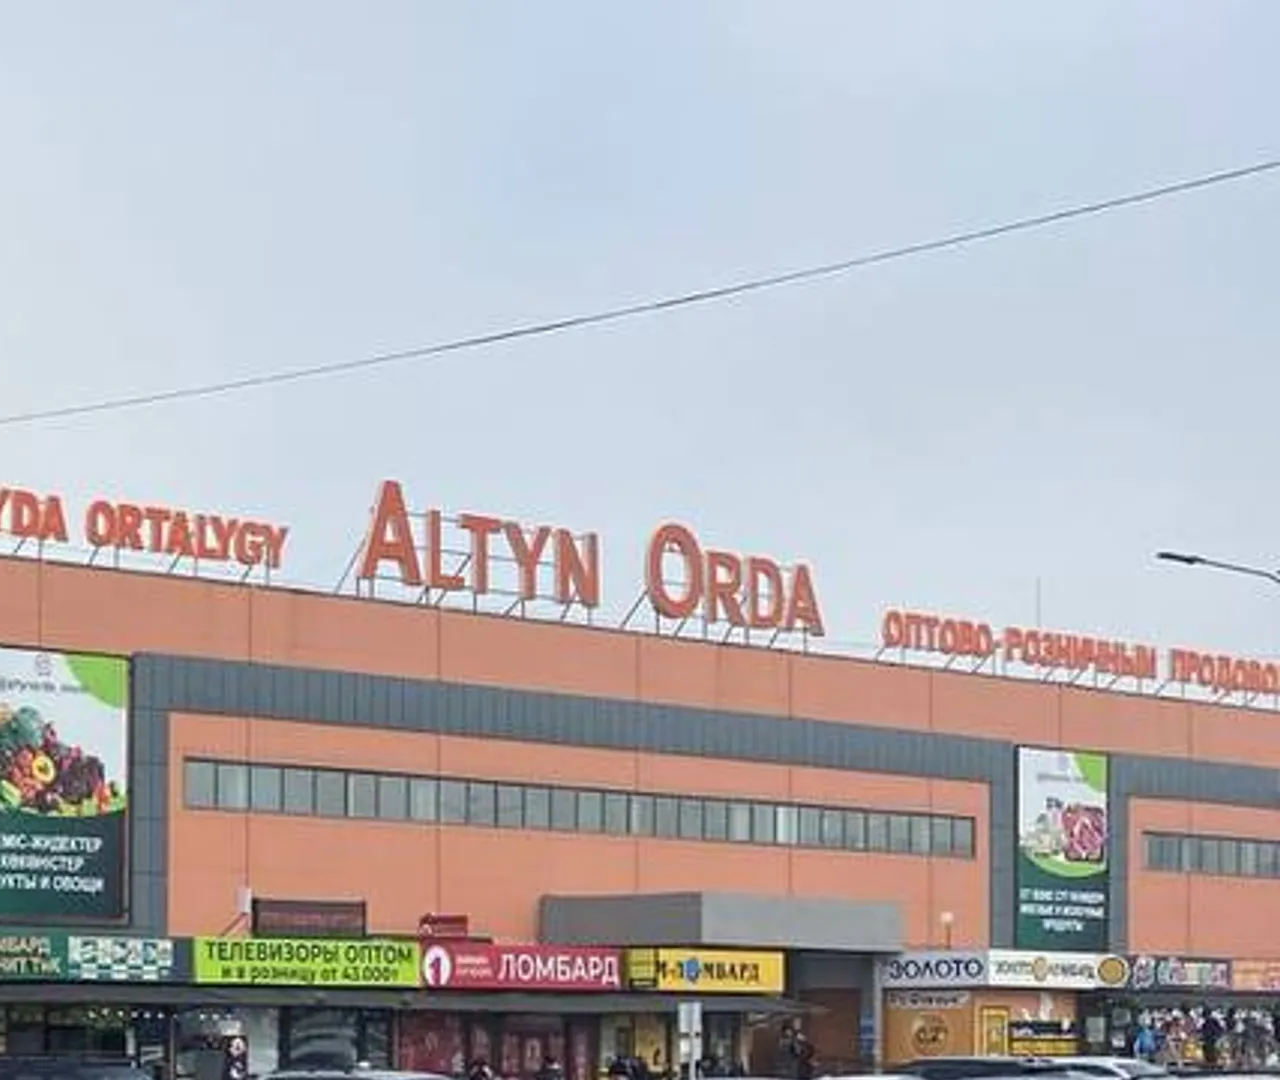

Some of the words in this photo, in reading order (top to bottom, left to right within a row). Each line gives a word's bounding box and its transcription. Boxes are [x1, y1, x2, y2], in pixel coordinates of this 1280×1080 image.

[85, 500, 289, 568] ORTALYGY
[361, 480, 599, 607] ALTYN
[647, 523, 825, 637] ORDA
[1170, 648, 1280, 695] ПРОДОВО
[206, 940, 339, 963] ТЕЛЕВИЗОРЫ
[344, 945, 414, 965] ОПТОМ
[890, 957, 984, 979] ЗОЛОТО
[251, 966, 316, 985] розницу
[319, 967, 337, 980] от
[497, 953, 620, 986] ЛОМБАРД
